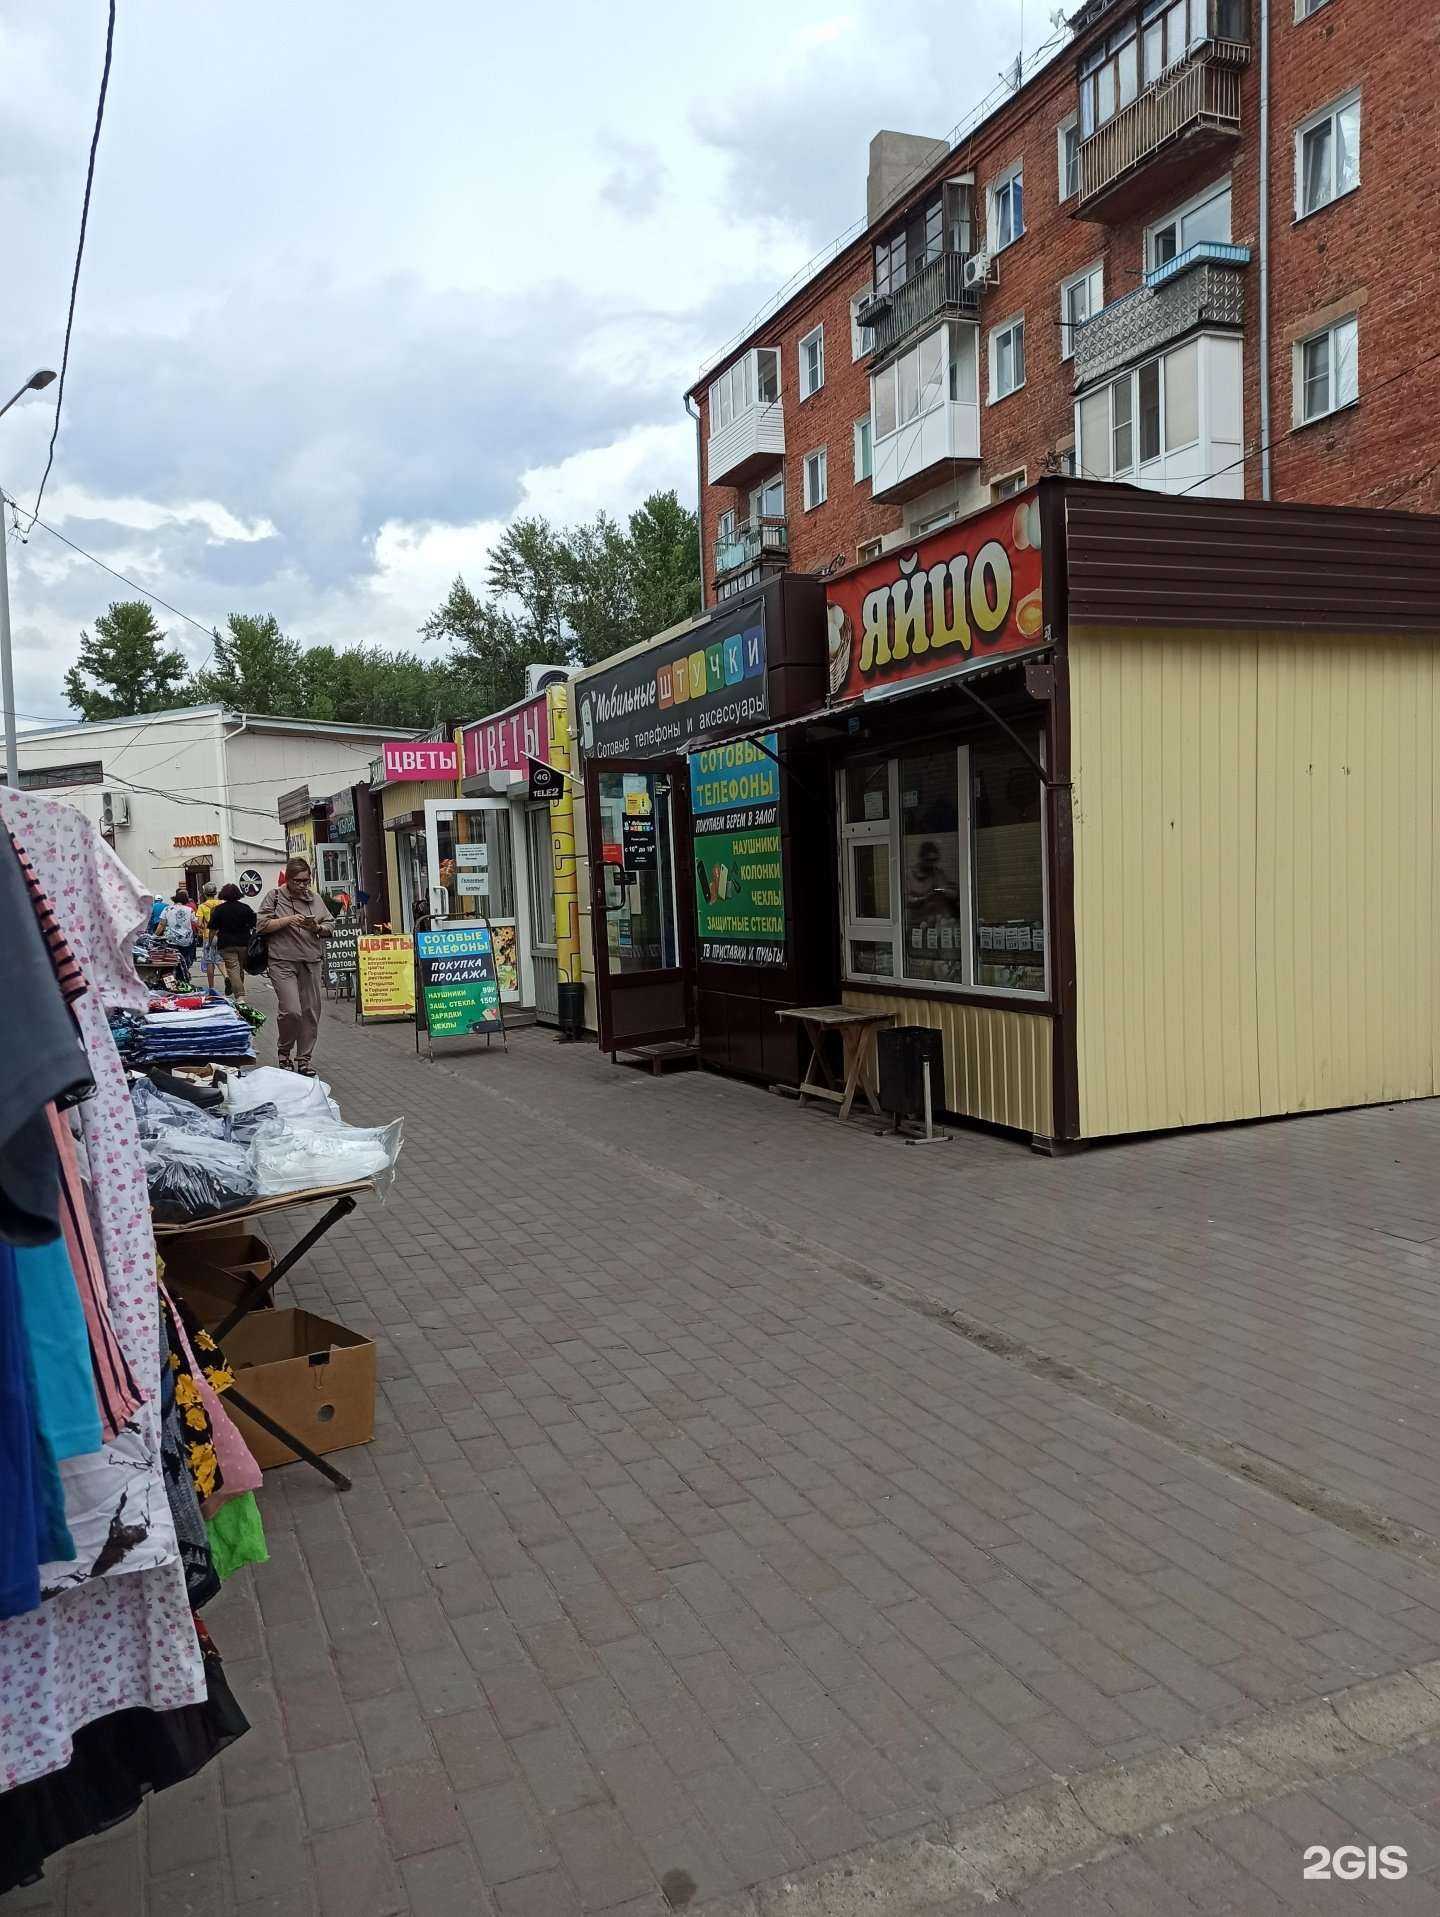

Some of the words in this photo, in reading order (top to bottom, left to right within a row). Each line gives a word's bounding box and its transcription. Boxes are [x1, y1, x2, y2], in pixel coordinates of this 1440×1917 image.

[859, 541, 1012, 672] ЯЙЦО
[595, 680, 656, 723] Мобильные
[660, 638, 758, 698] ШТУЧКИ
[597, 737, 630, 759] Сотовые
[635, 725, 681, 751] телефоны
[687, 717, 693, 732] и
[699, 695, 765, 730] аксессуары
[474, 706, 540, 774] ЦВЕТЫ
[387, 751, 456, 773] ЦВЕТЫ
[533, 788, 559, 797] TELE2
[697, 770, 773, 806] ТЕЛЕФОНЫ
[726, 814, 746, 829] БЕРЕМ
[755, 808, 776, 826] ЗАЛОГ
[173, 834, 220, 848] ЛОМБАРД
[733, 836, 779, 855] НАУШНИКИ
[741, 864, 780, 880] КОЛОНКИ
[752, 891, 782, 906] ЧЕХЛЫ
[707, 916, 749, 932] ЗАЩИТНЫЕ
[752, 917, 783, 932] СТЕКЛА
[332, 928, 362, 937] ЛЮЧИ
[424, 932, 483, 944] СОТОВЫЕ
[325, 940, 356, 949] ЗАМК
[421, 942, 488, 955] ТЕЛЕФОНЫ
[431, 959, 482, 971] ПОКУПКА
[431, 969, 487, 982] ПРОДАЖА
[428, 990, 467, 999] НАУШНИКИ
[449, 999, 476, 1007] СТЕКЛА
[431, 1011, 462, 1020] ЗАРЯДКИ
